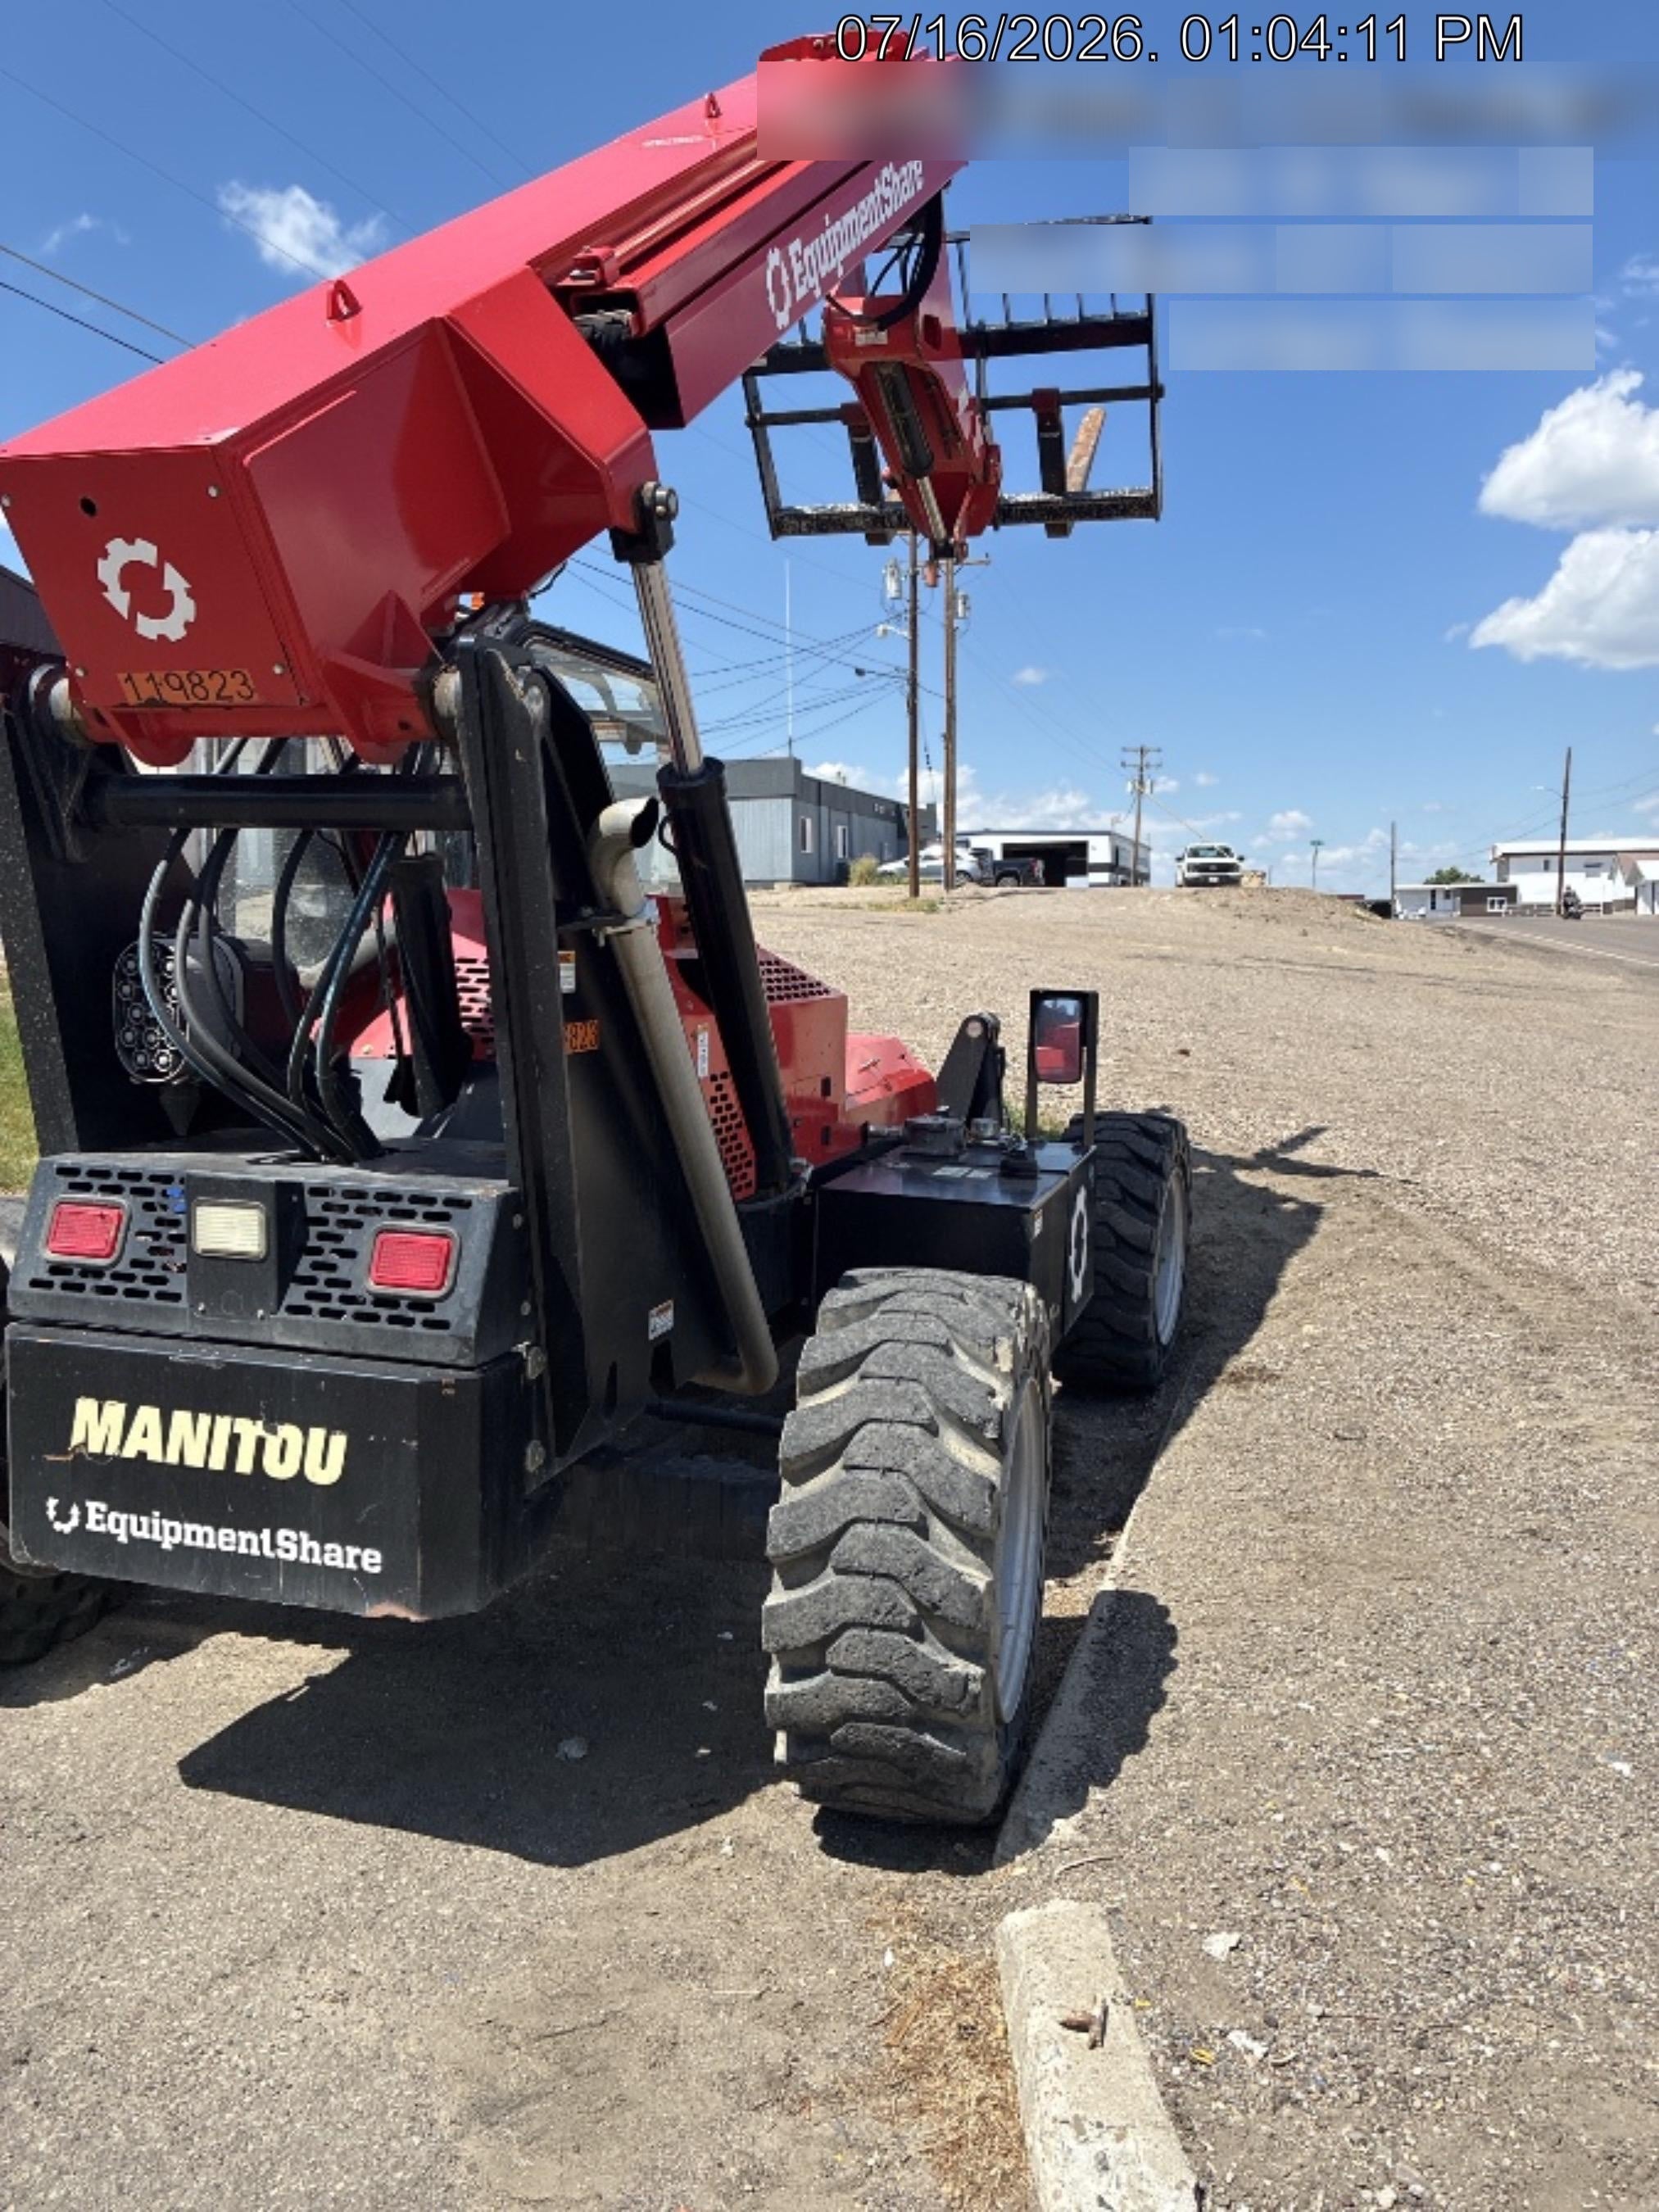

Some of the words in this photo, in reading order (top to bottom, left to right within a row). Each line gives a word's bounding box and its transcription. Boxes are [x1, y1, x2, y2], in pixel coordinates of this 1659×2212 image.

[788, 161, 922, 301] EquipmentShare
[125, 671, 254, 701] 119823
[69, 1396, 347, 1485] MANITOU
[85, 1500, 382, 1574] EquipmentShare
